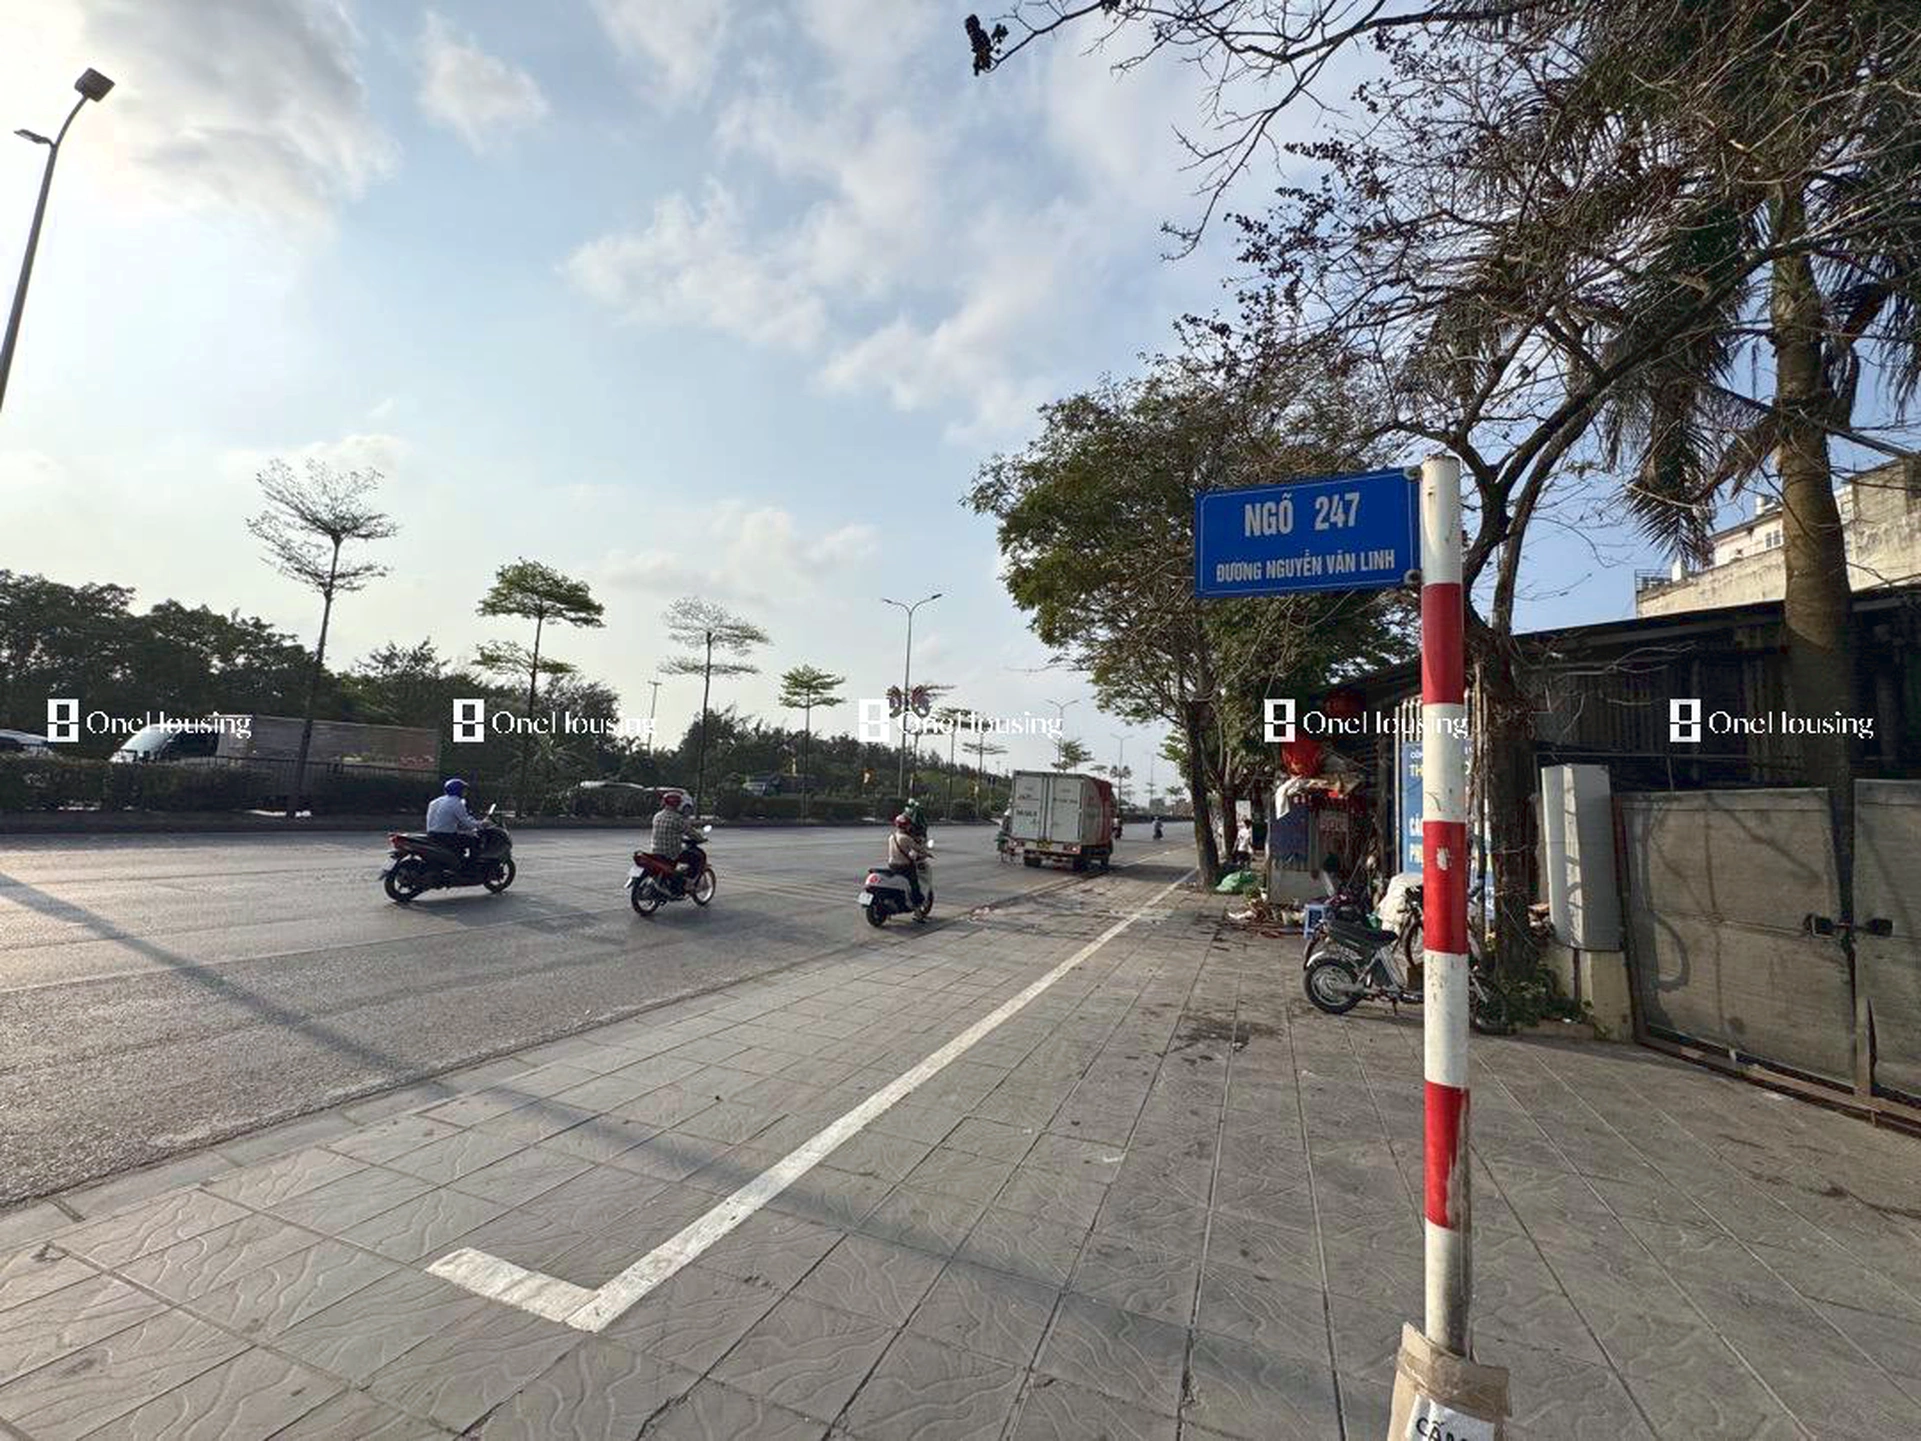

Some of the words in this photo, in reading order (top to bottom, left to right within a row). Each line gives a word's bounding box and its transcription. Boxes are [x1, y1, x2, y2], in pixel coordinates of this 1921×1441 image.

[1244, 492, 1294, 537] NGÕ
[1314, 492, 1360, 531] 247
[1216, 557, 1262, 583] ĐƯỜNG
[1266, 549, 1322, 579] NGUYỄN
[1326, 549, 1356, 574] VĂN
[1360, 549, 1395, 572] LINH
